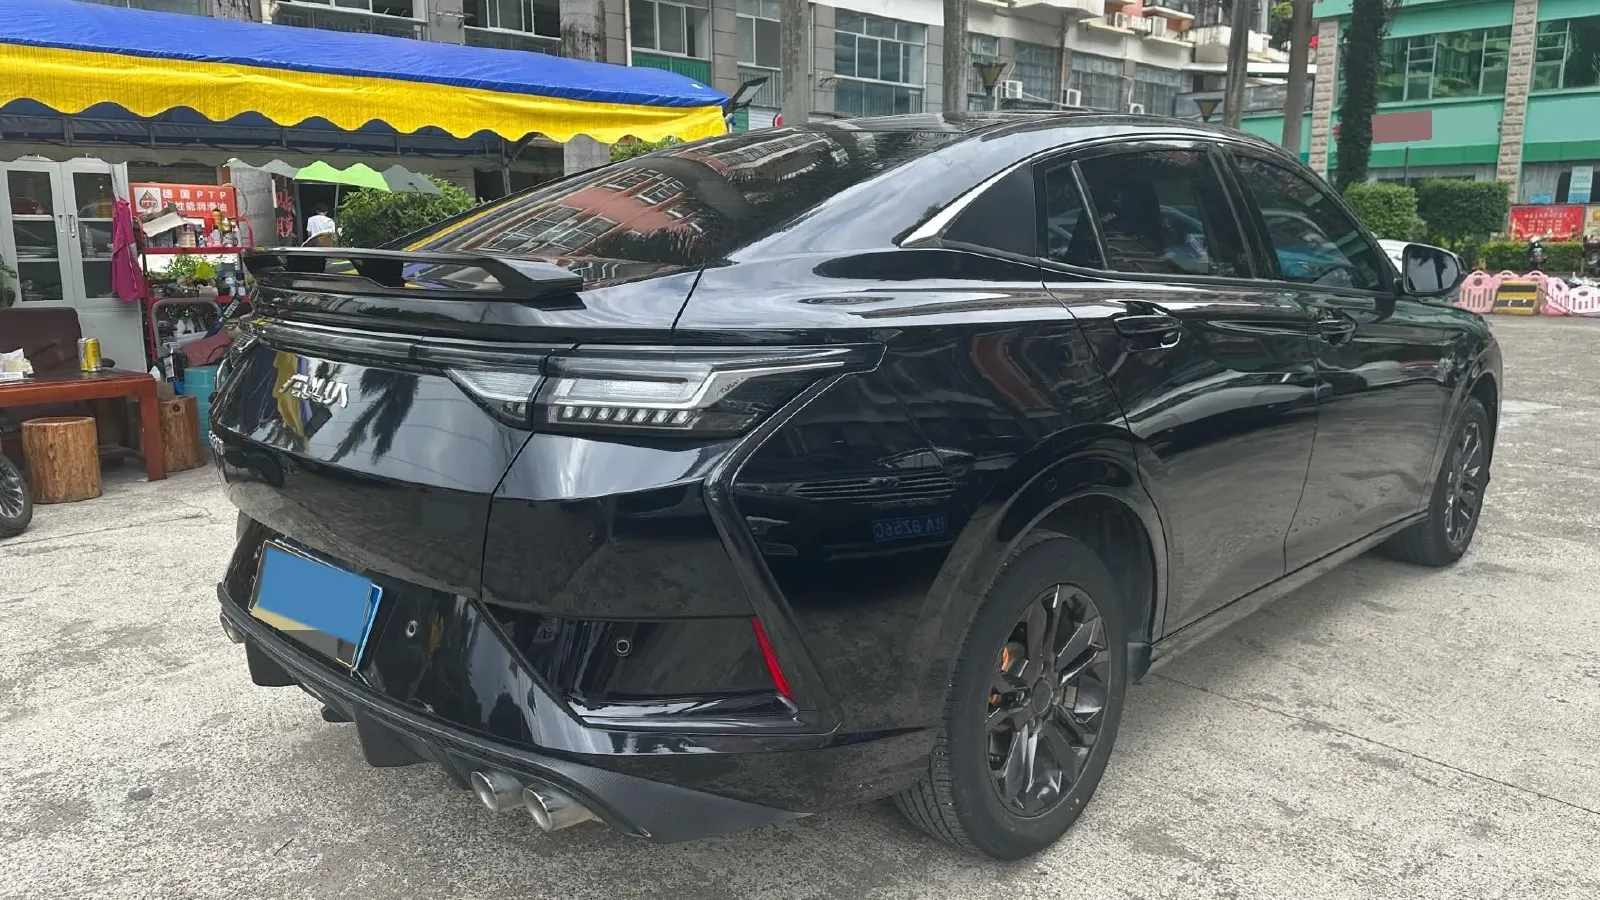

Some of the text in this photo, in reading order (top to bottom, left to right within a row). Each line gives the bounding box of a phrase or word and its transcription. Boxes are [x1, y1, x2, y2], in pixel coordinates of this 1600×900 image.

[162, 200, 228, 212] 性能润滑油
